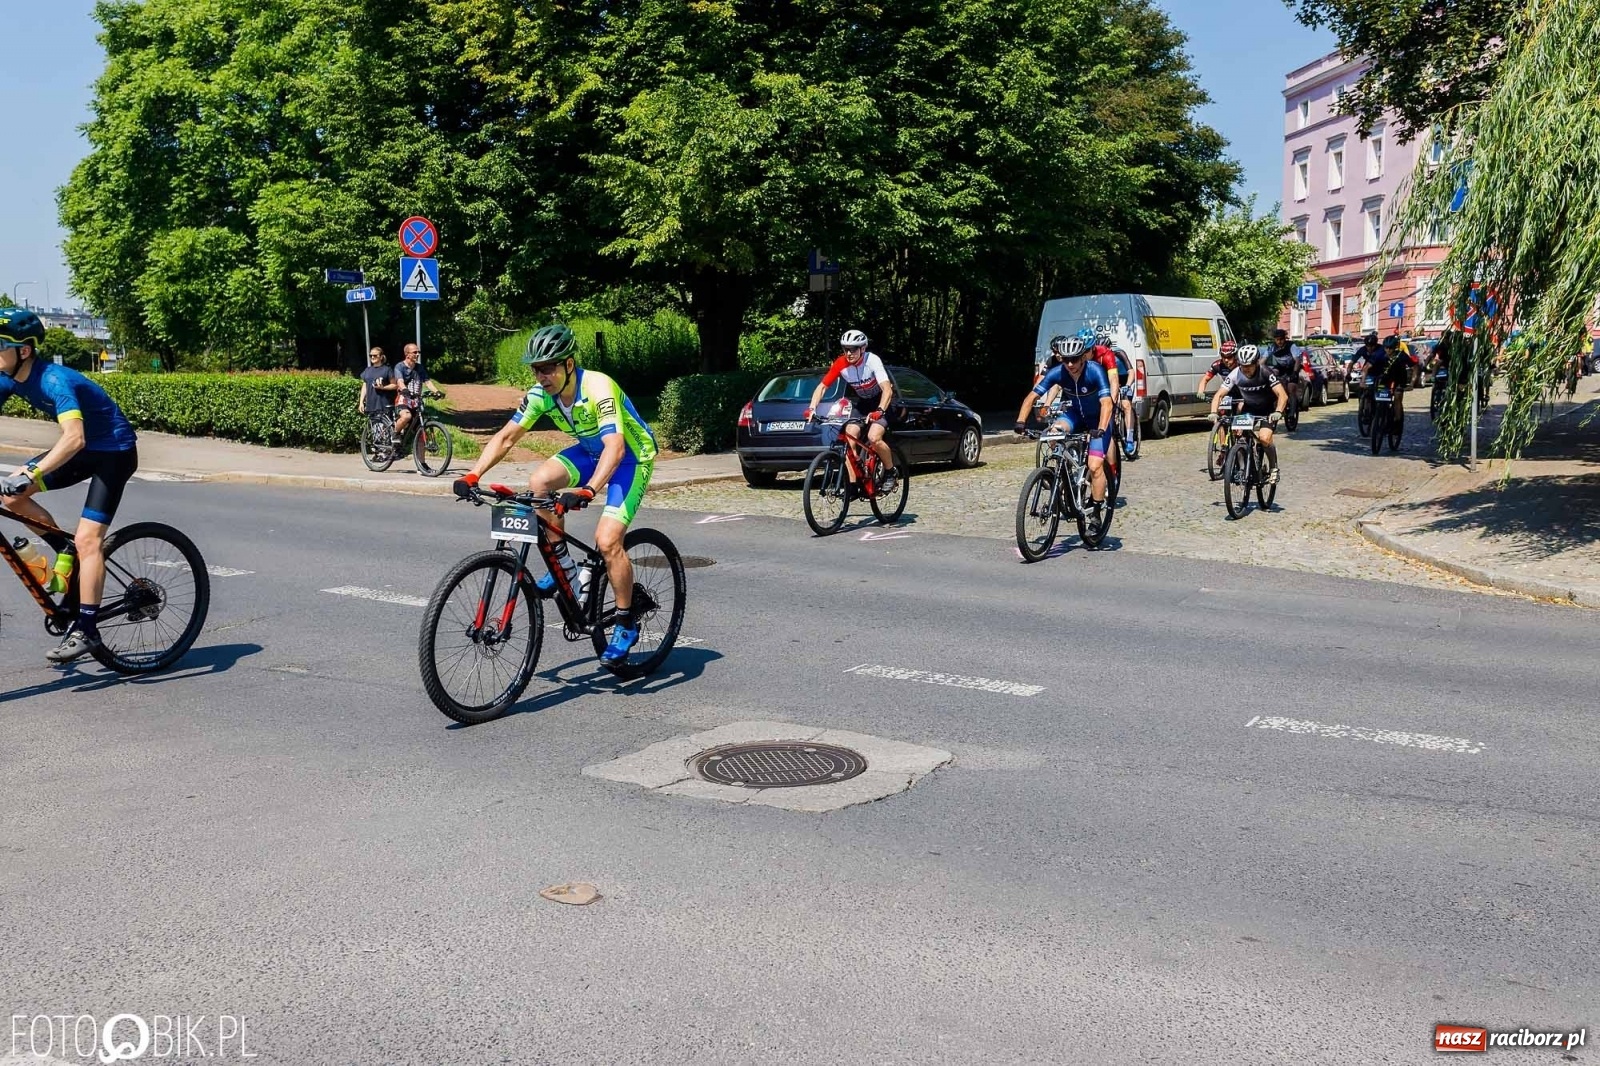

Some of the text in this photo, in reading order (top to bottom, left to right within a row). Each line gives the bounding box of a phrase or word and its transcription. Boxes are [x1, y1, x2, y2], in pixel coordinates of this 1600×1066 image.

[1301, 285, 1314, 301] P
[1096, 324, 1118, 333] OUT
[500, 516, 530, 531] 1262
